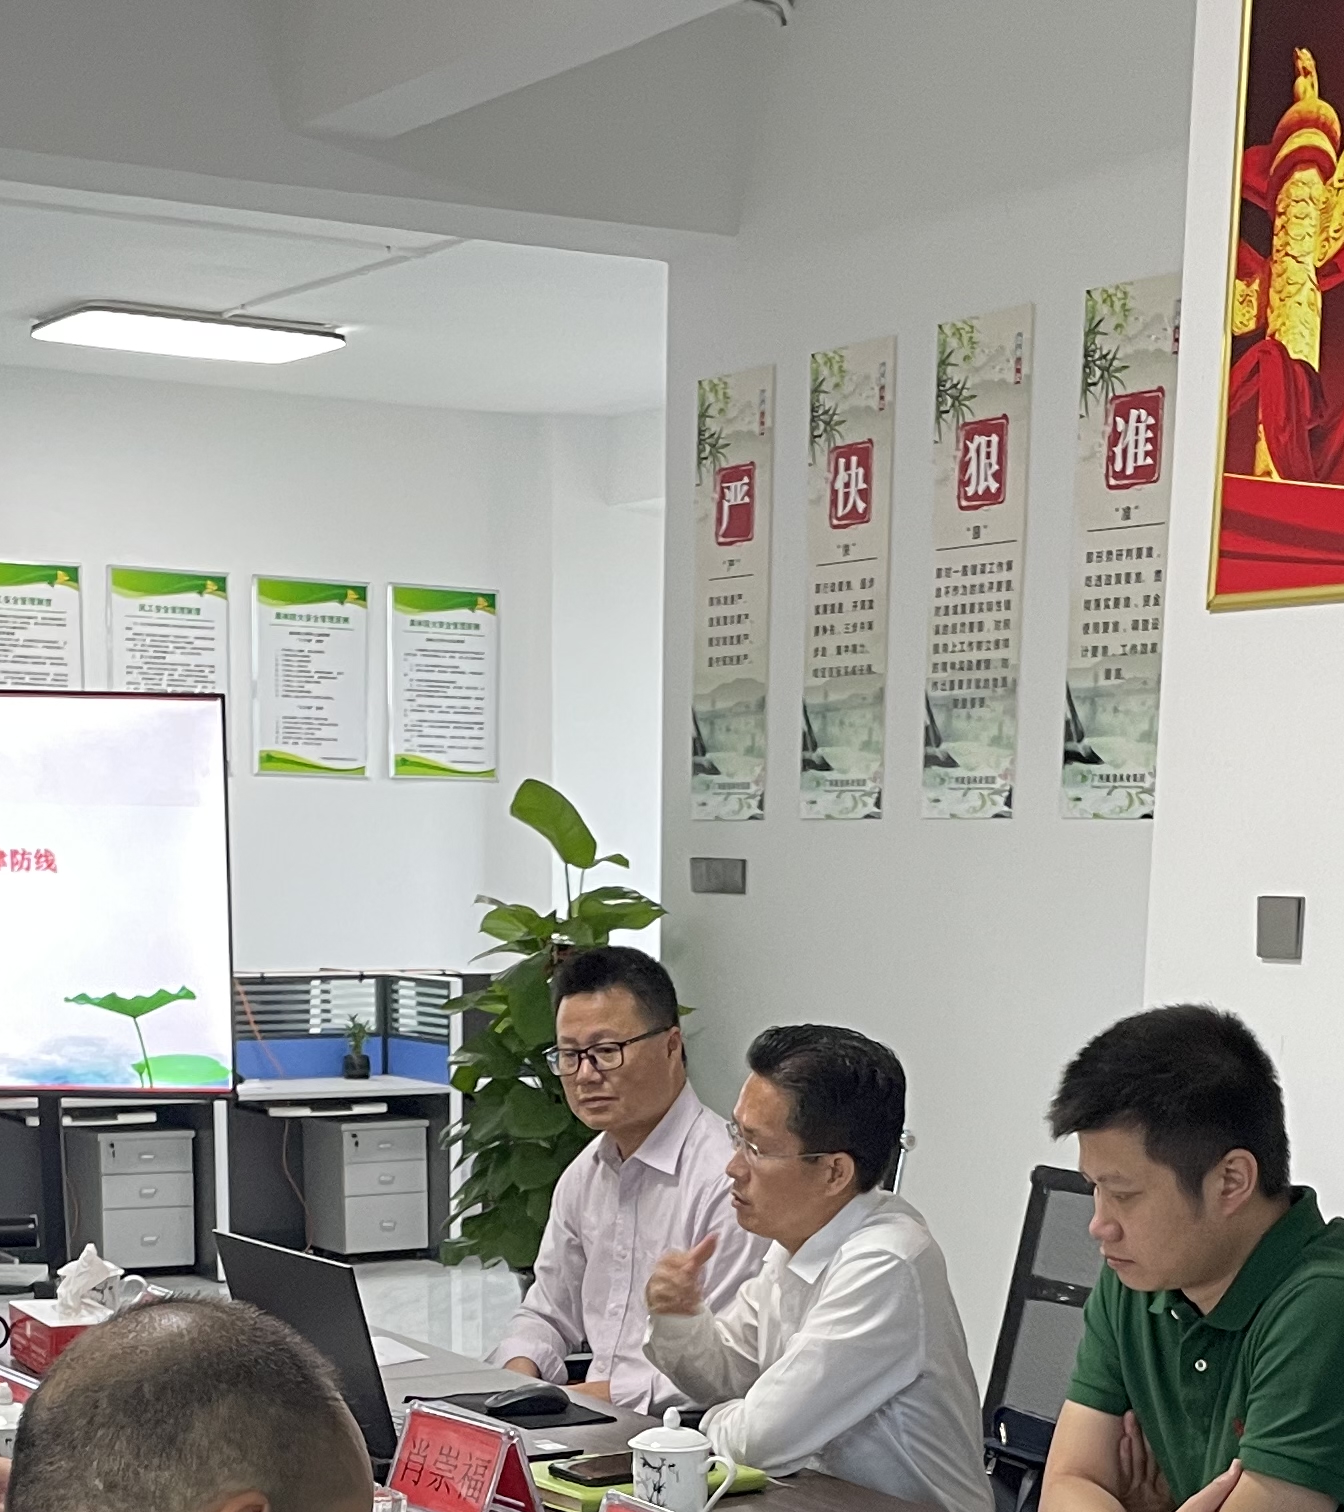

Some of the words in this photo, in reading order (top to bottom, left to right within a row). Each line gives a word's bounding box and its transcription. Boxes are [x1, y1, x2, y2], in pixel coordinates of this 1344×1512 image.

[964, 434, 1002, 498] 狠
[1112, 408, 1154, 476] 准
[722, 478, 752, 532] 严
[836, 456, 869, 517] 快
[399, 1437, 492, 1504] 肖崇福
